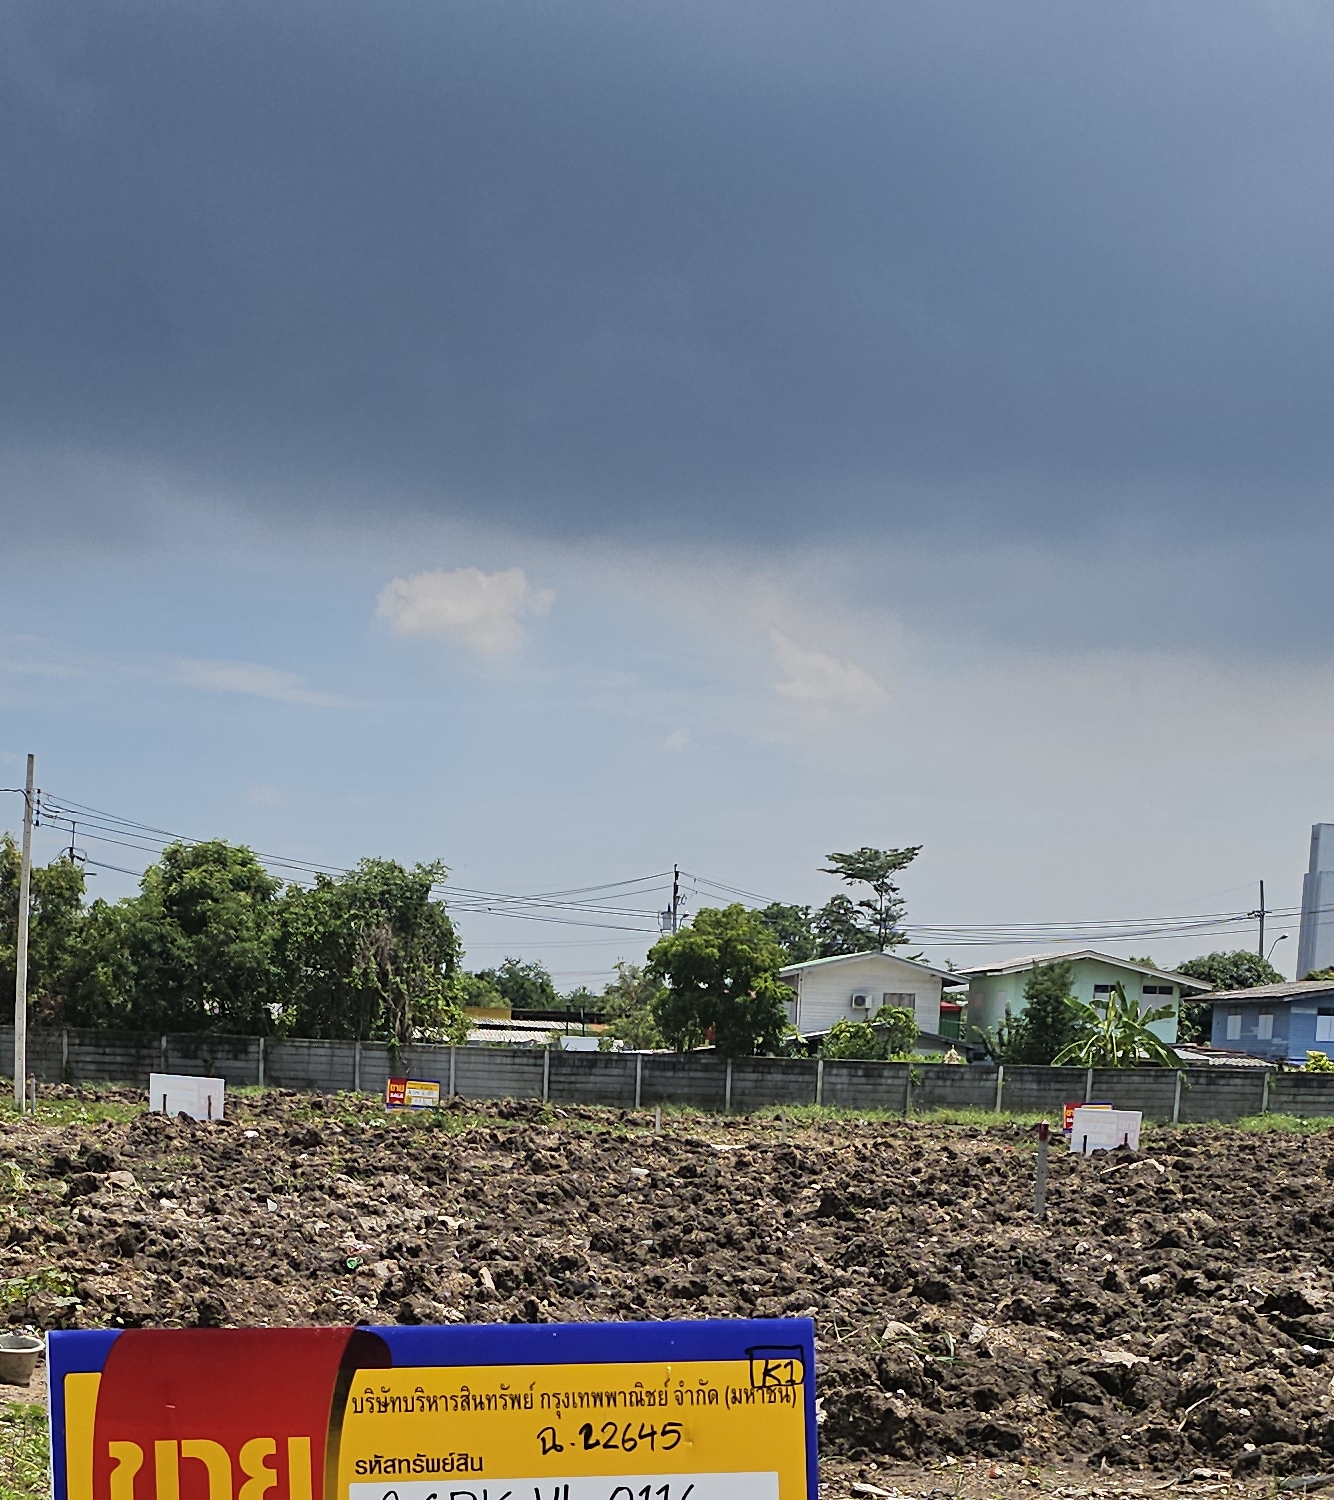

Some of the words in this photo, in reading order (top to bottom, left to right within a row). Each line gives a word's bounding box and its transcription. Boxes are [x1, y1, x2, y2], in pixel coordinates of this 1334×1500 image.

[351, 1381, 537, 1415] บริษัทบริหารสินทรัพย์
[540, 1376, 671, 1419] กรุงเทพพาณิชย์
[674, 1379, 719, 1406] จำกัด
[354, 1452, 484, 1476] รหัสทรัพย์สิน
